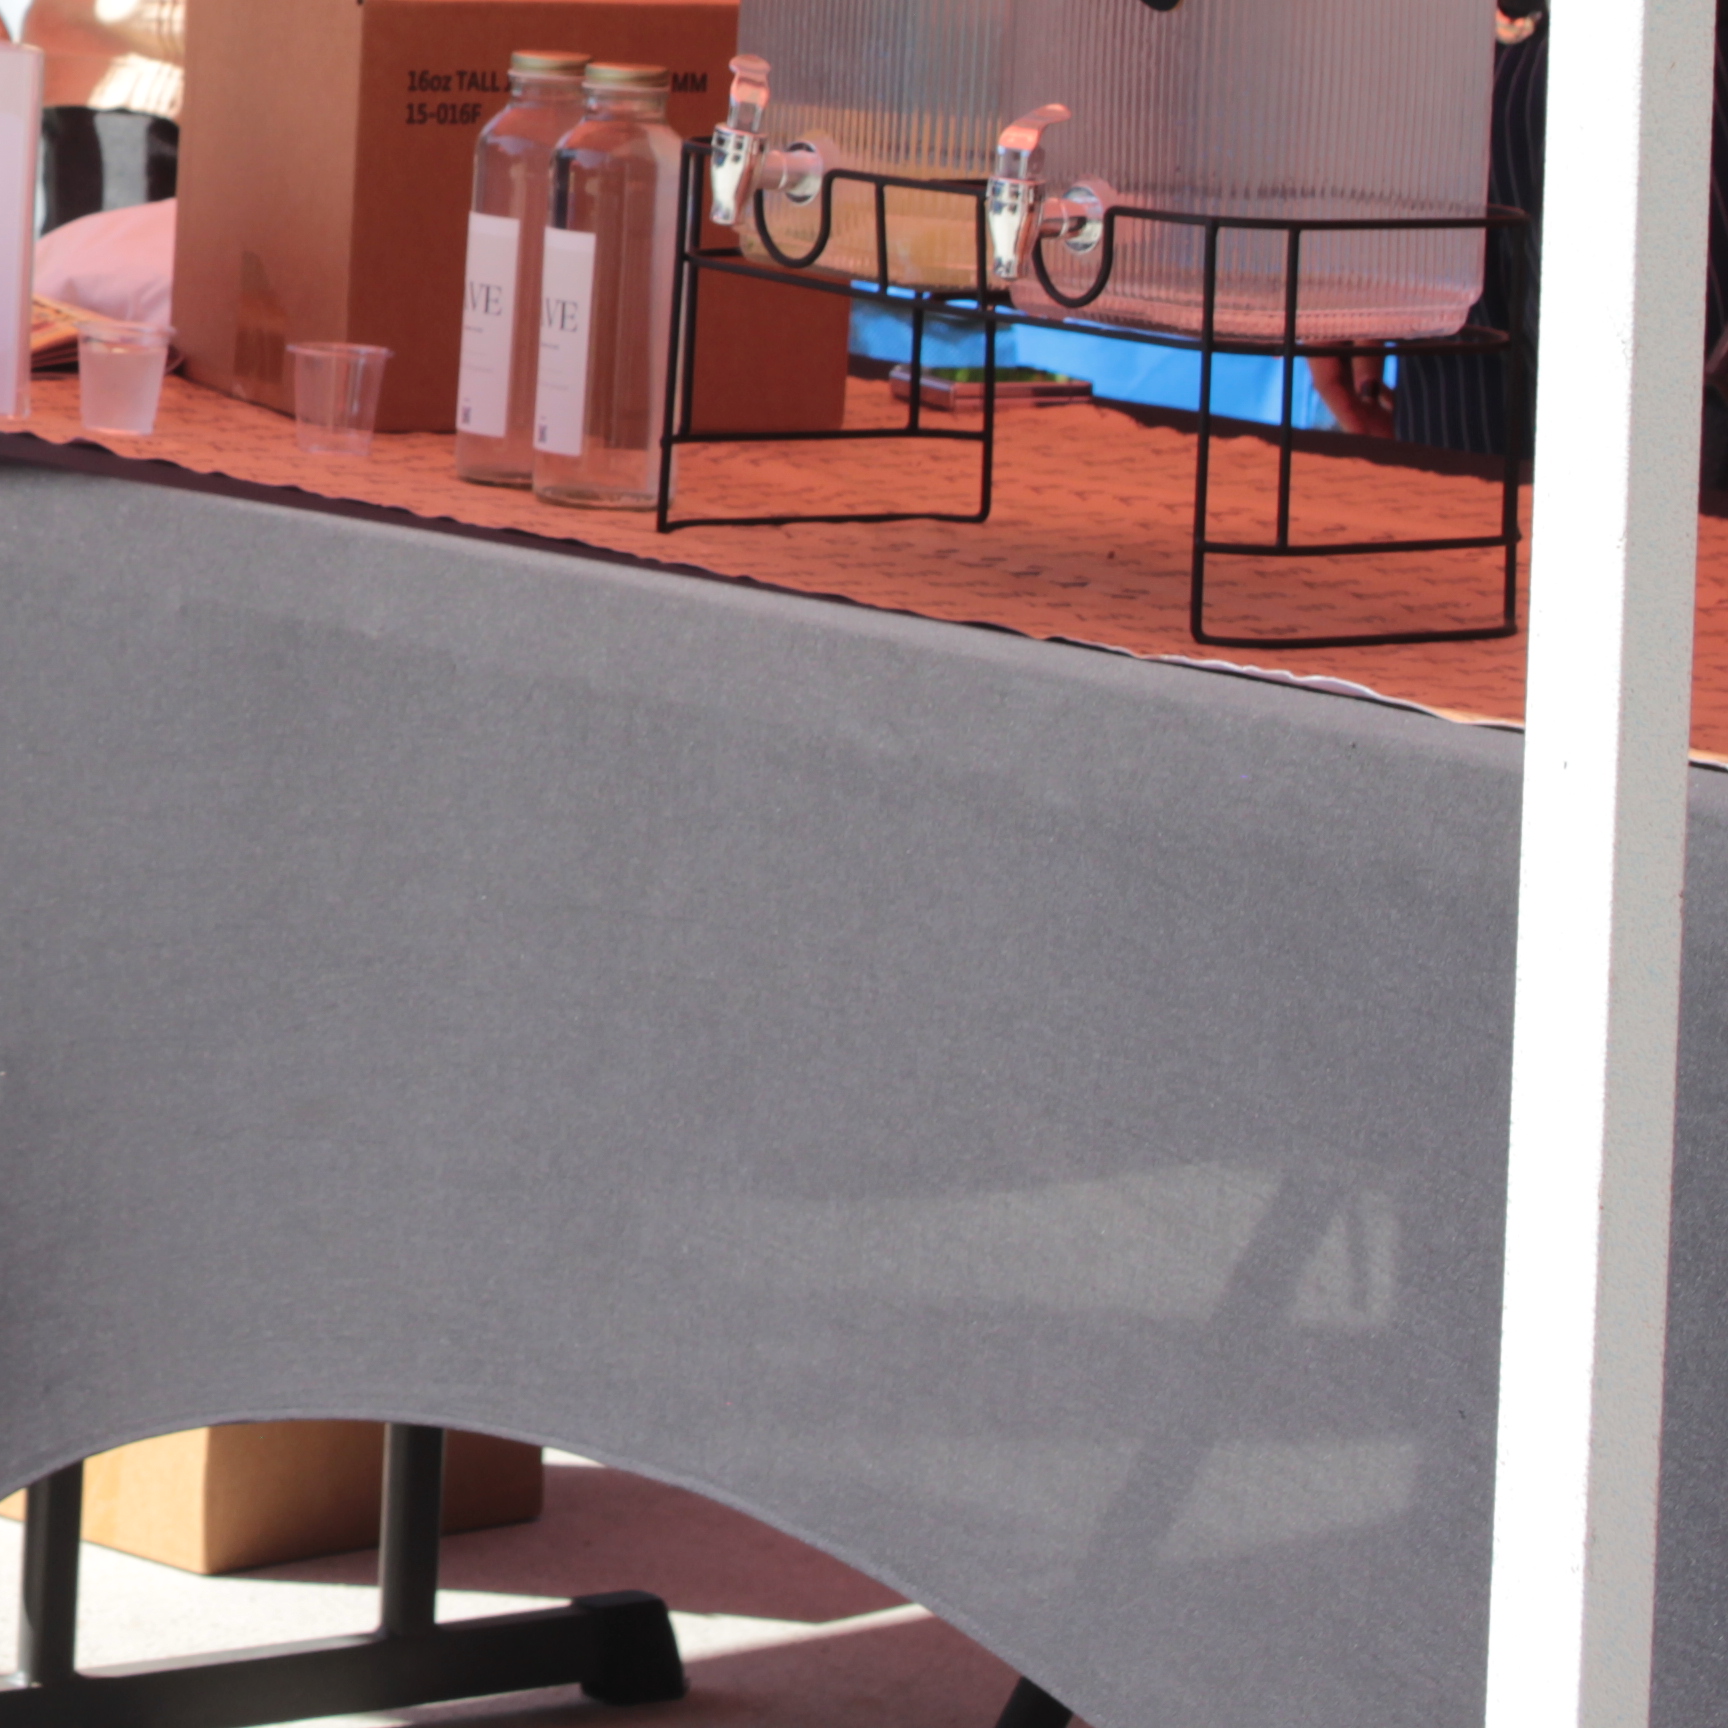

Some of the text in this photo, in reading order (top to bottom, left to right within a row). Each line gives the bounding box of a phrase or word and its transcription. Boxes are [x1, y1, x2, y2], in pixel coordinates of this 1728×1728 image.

[407, 70, 452, 92] 16oz
[456, 70, 501, 92] TALL
[405, 102, 482, 125] 15-016F
